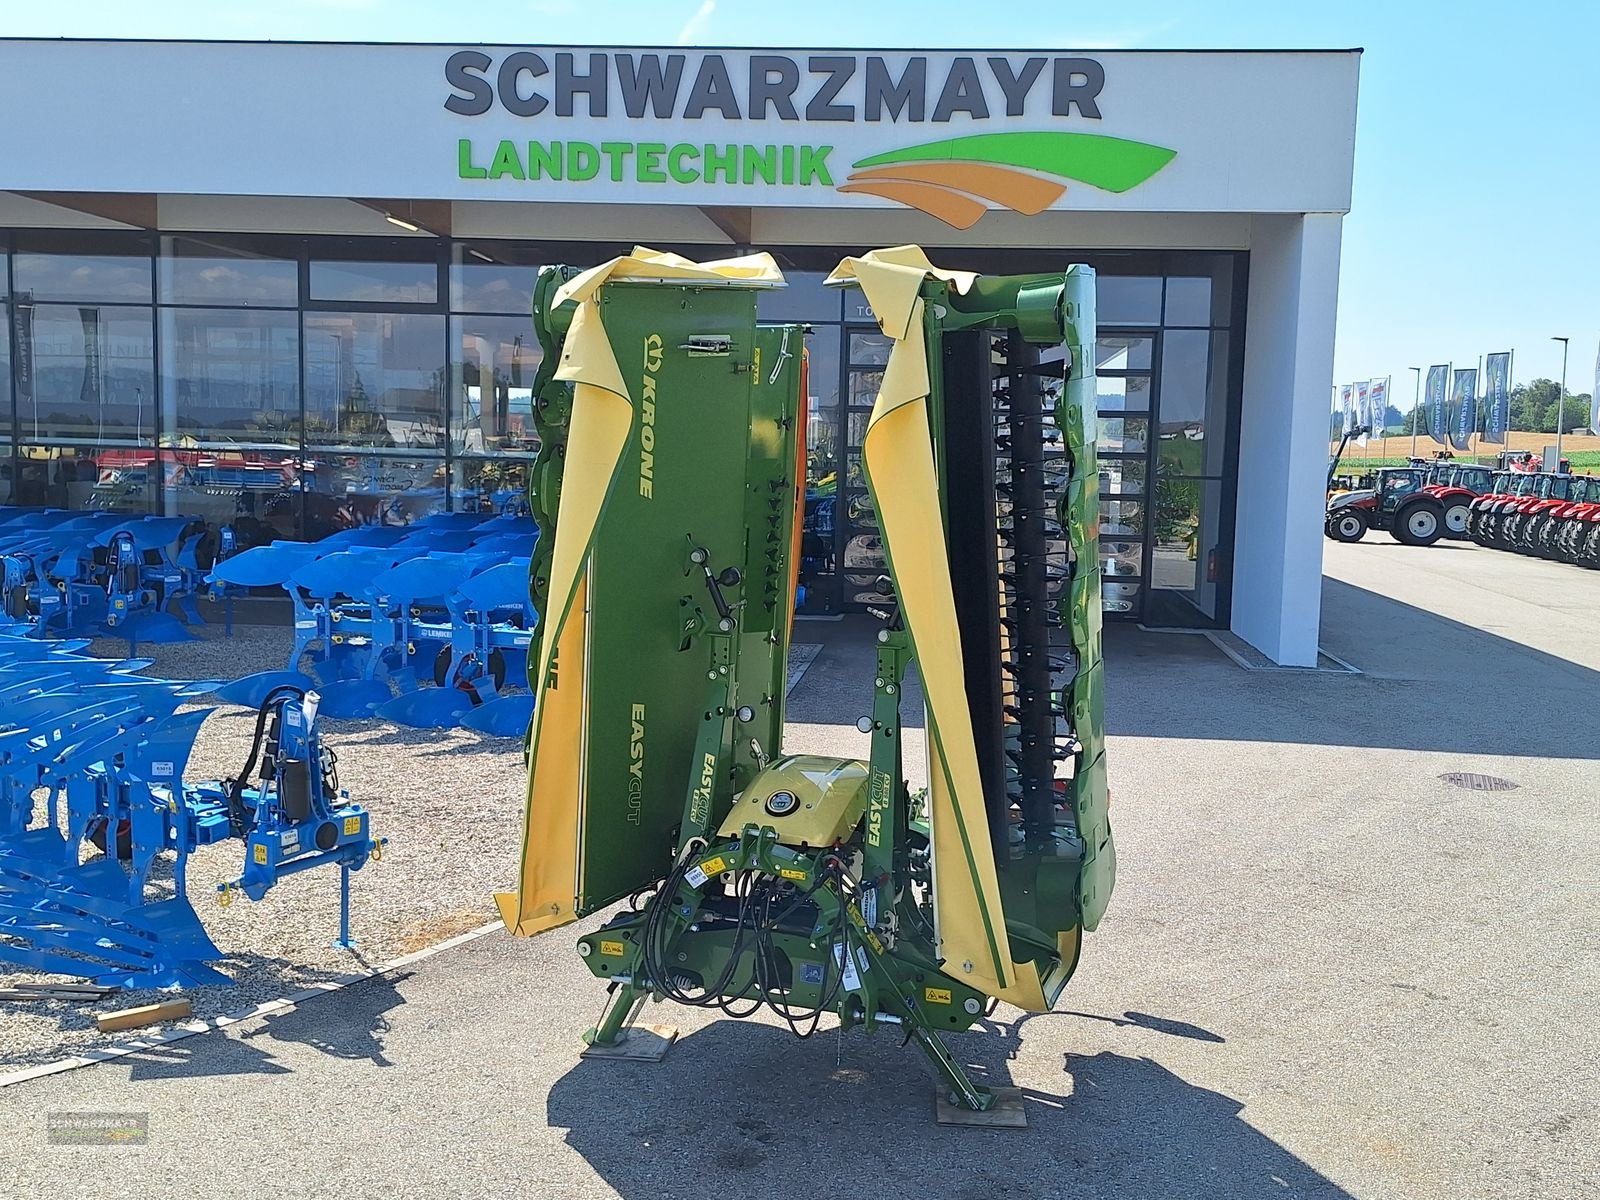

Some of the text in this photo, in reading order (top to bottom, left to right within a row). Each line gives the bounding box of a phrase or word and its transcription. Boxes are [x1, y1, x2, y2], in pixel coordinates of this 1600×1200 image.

[443, 50, 1105, 123] SCHWARZMAYR
[458, 139, 834, 186] LANDTECHNIK
[639, 374, 657, 500] KRONE
[428, 629, 453, 638] LEMKE
[626, 703, 645, 826] EASYCUT
[695, 752, 716, 832] EASYCUT
[868, 766, 884, 847] EASYCUT
